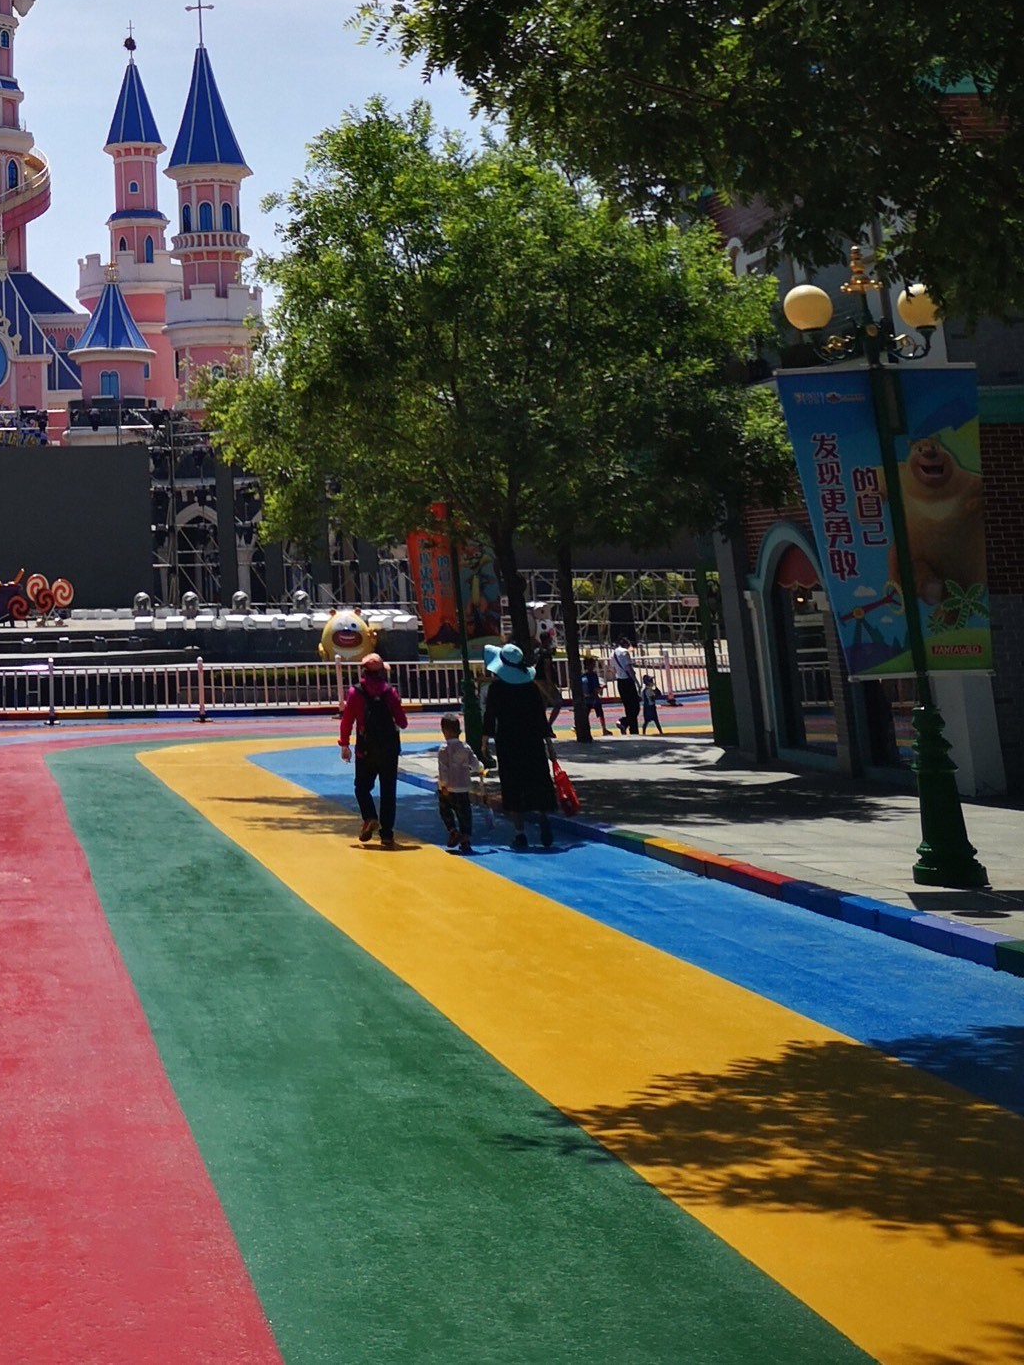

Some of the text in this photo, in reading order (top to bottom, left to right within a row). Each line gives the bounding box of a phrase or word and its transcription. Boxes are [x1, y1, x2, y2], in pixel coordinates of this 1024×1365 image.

[812, 433, 858, 581] 发现更勇敢
[852, 467, 887, 545] 的自己
